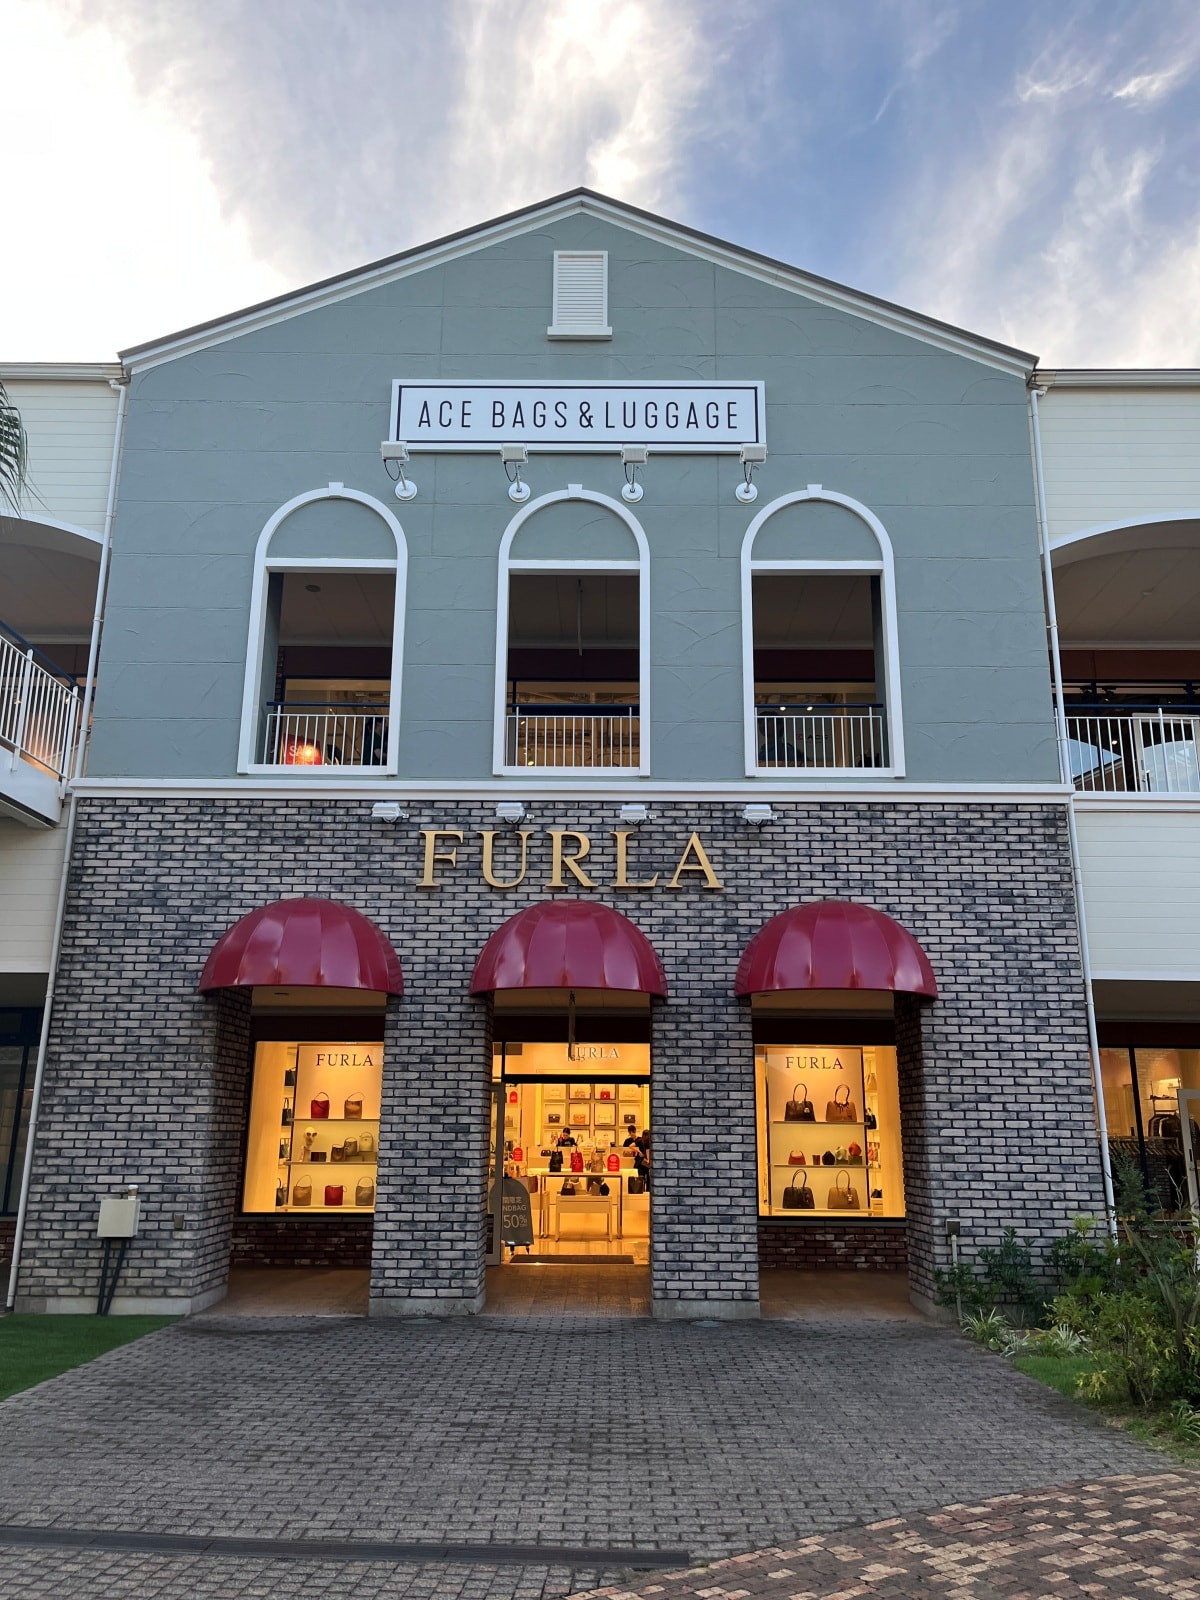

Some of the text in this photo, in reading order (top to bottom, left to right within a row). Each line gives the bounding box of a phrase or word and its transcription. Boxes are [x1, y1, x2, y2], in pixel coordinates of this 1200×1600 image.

[418, 400, 472, 428] ACE
[416, 830, 724, 889] FURLA
[568, 1046, 619, 1059] URLA
[316, 1053, 374, 1067] FURLA
[786, 1056, 844, 1070] FURLA
